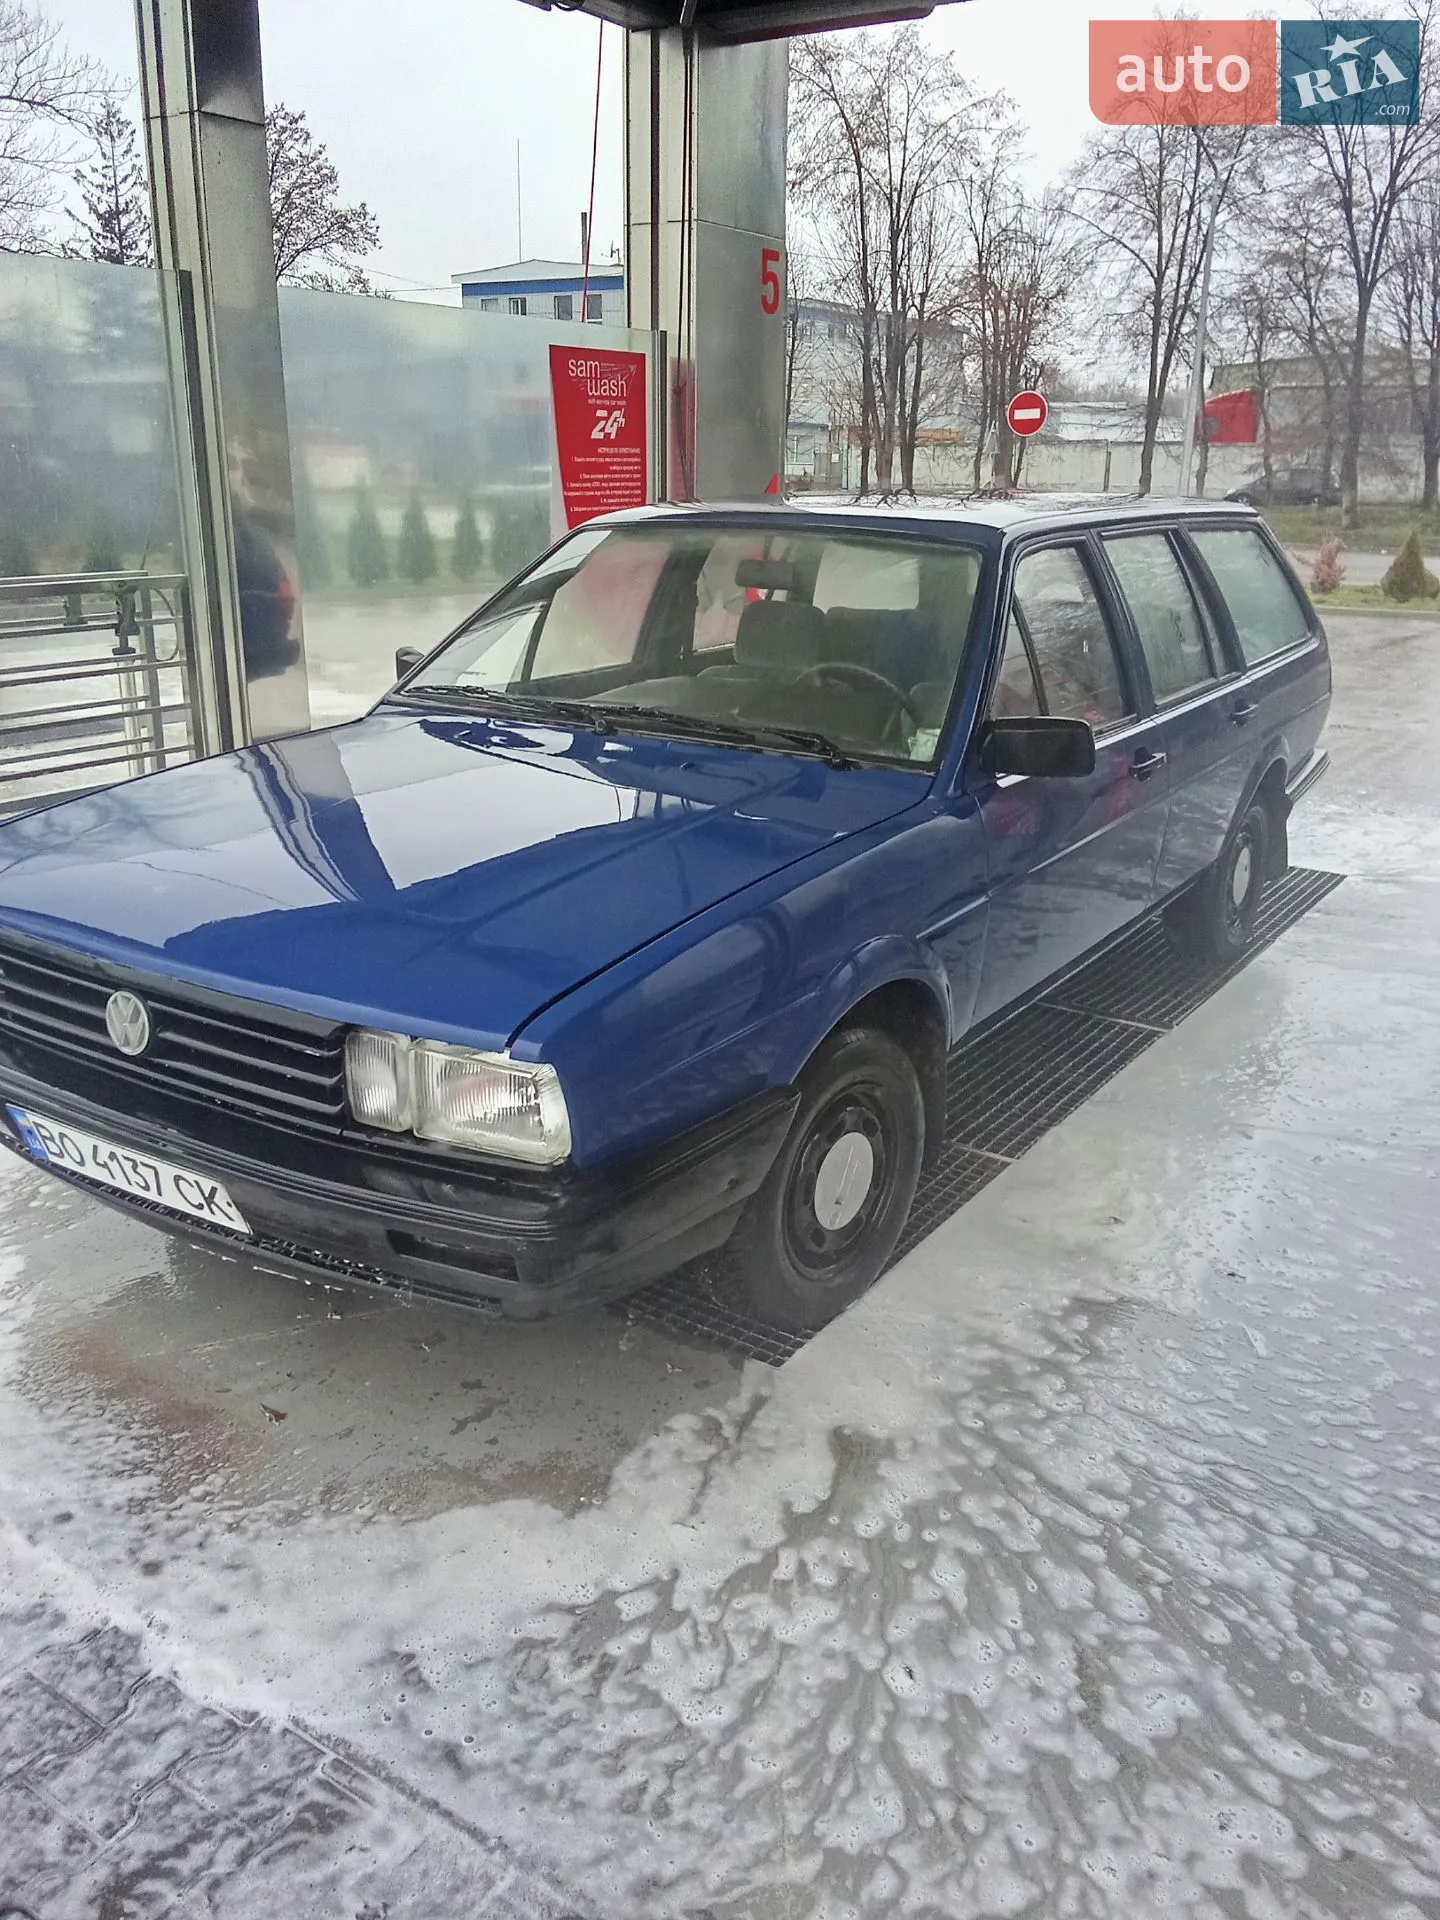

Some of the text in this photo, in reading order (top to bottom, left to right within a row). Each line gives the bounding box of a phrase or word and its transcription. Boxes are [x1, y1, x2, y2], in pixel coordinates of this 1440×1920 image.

[761, 247, 780, 314] 5
[568, 359, 600, 378] sam
[587, 374, 627, 397] wash
[32, 1120, 236, 1223] BO 4137 CK
